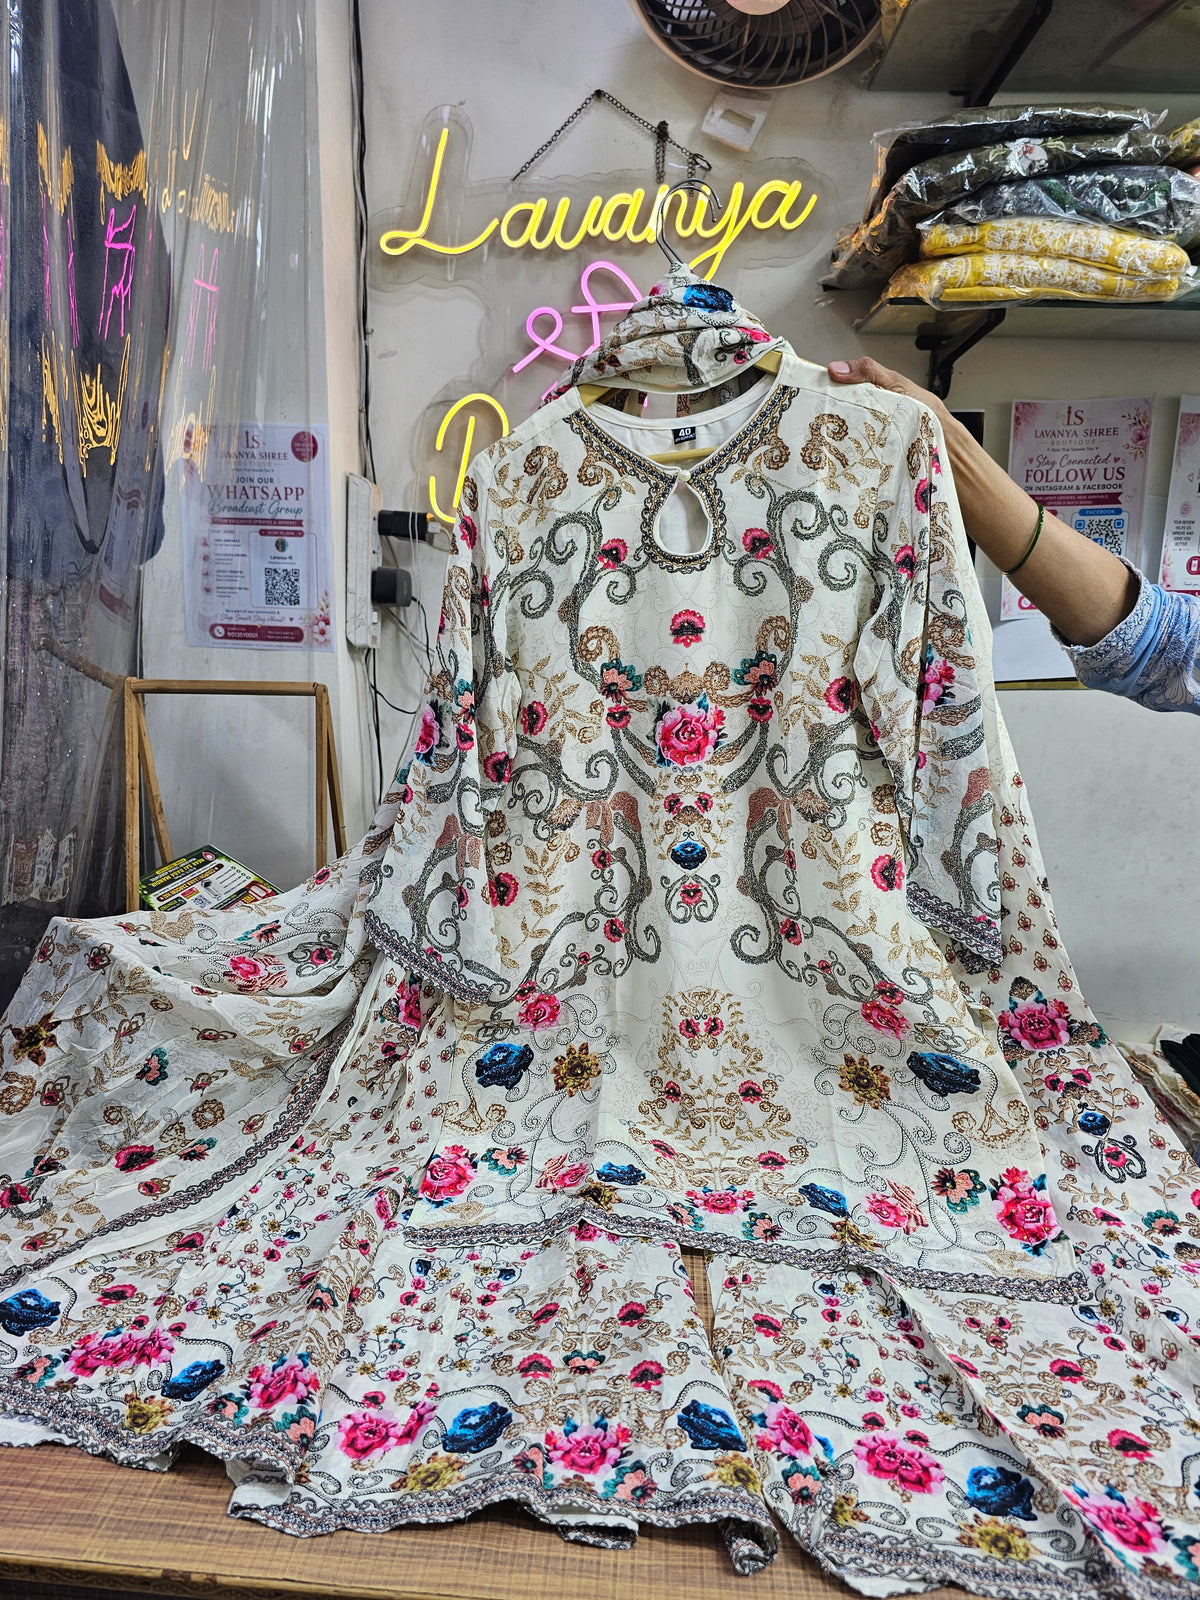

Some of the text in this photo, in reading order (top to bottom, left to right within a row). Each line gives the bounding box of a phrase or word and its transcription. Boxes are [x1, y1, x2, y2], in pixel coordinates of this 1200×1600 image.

[678, 428, 691, 437] 40
[1034, 426, 1120, 439] LAVANYA SHREE
[259, 452, 289, 461] SHREE
[1035, 452, 1112, 470] Stay Connected
[1025, 466, 1126, 483] FOLLOW US
[207, 485, 305, 501] WHATSAPP
[1034, 484, 1074, 492] INSTAGRAM
[1082, 483, 1124, 491] FACEBOOK
[208, 499, 303, 519] Broadcast Group
